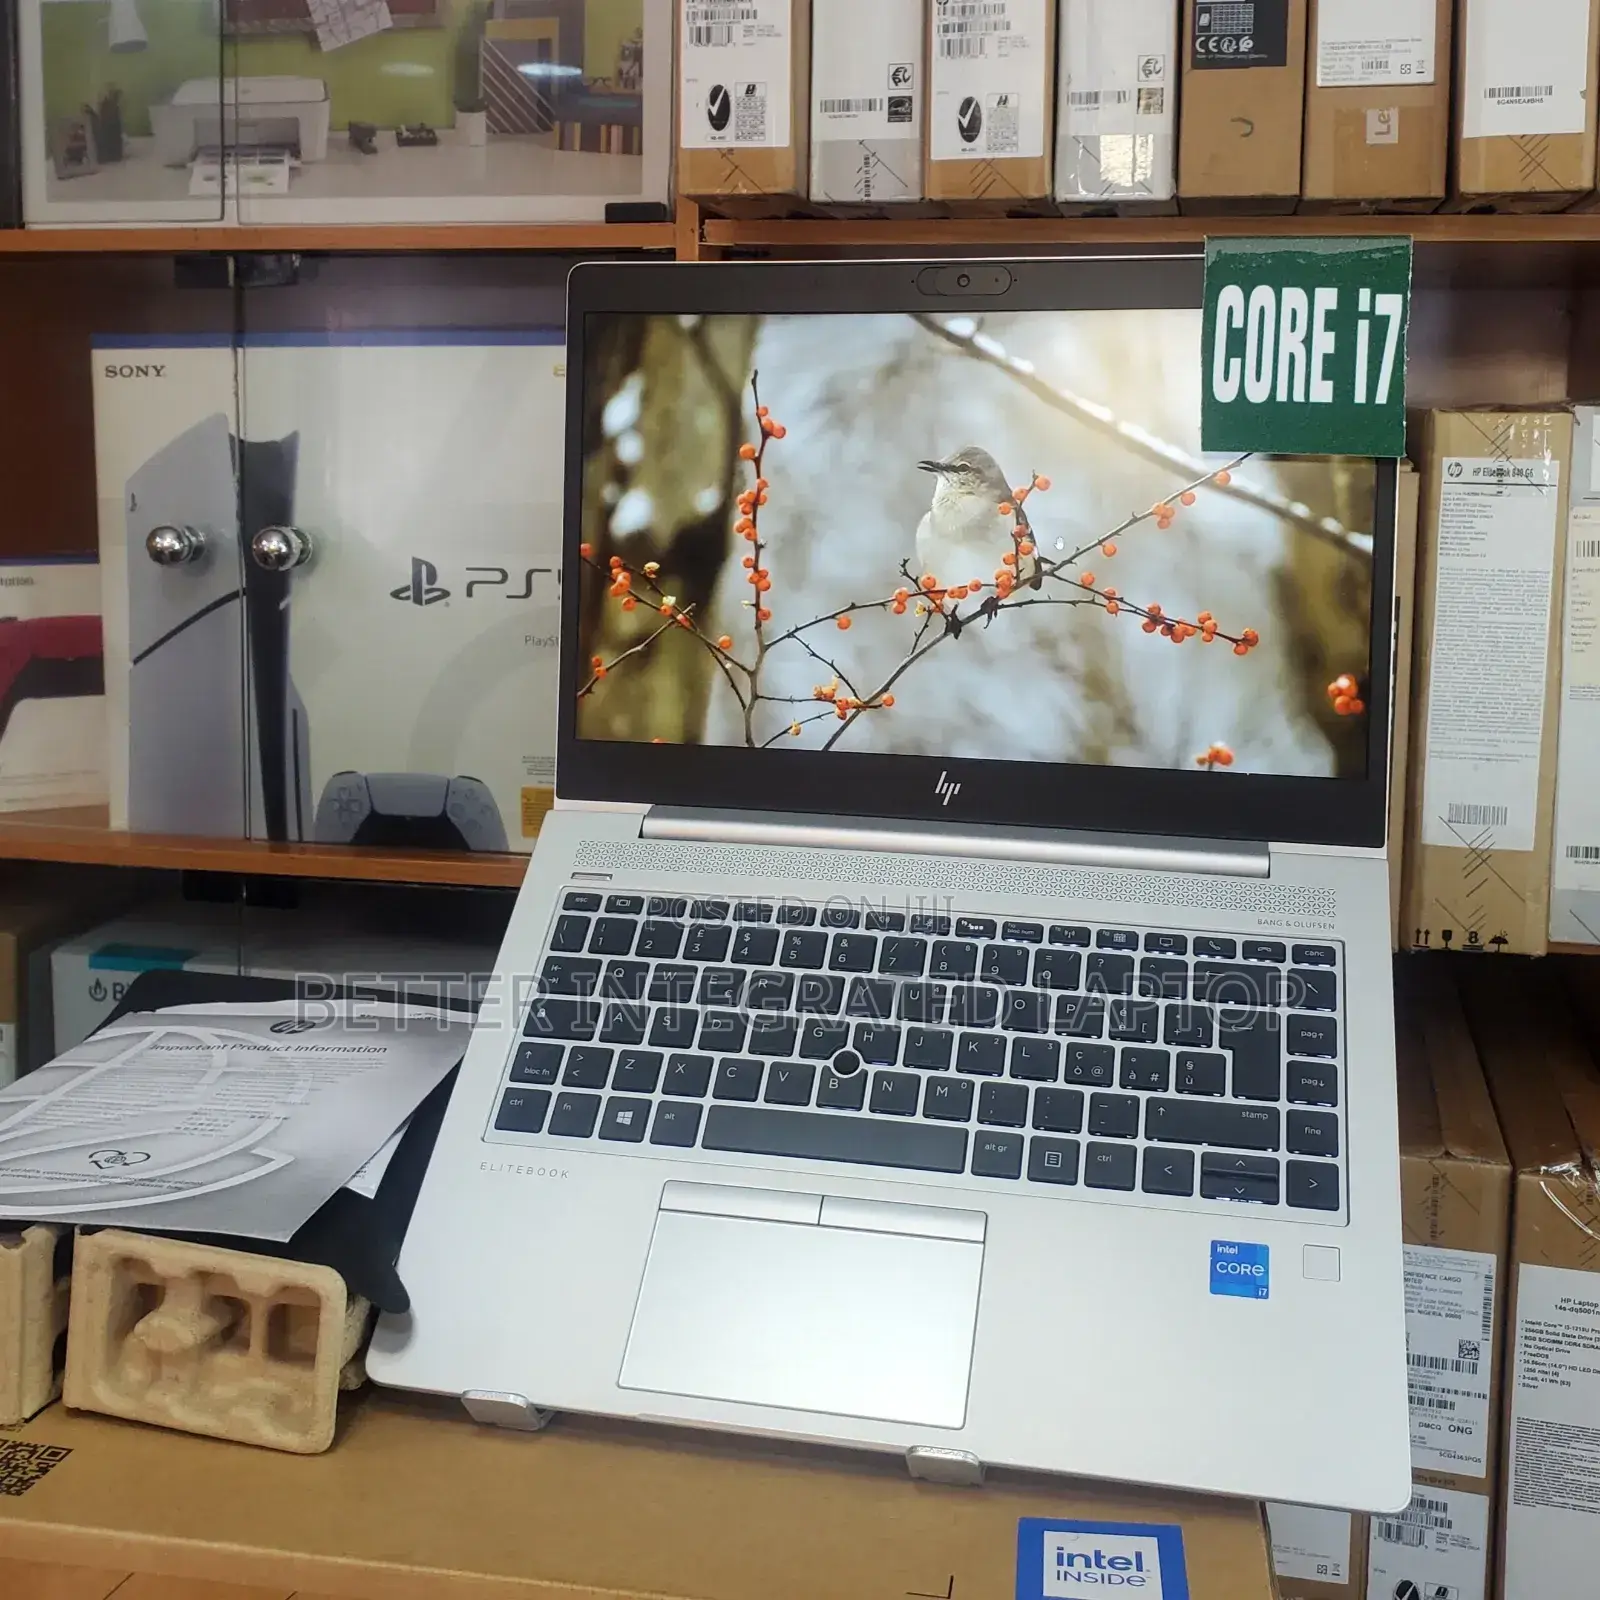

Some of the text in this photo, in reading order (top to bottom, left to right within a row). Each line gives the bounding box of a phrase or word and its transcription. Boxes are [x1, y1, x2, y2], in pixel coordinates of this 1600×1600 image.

[1212, 285, 1403, 405] CORE i7
[105, 364, 166, 378] SONY
[935, 771, 961, 805] hp
[1257, 918, 1283, 928] BANG
[1293, 920, 1335, 930] OLUFSEN
[644, 940, 653, 949] 2
[692, 943, 700, 952] 3
[740, 947, 749, 956] 4
[788, 951, 797, 960] 5
[1304, 949, 1325, 958] canc
[838, 954, 846, 963] 6
[889, 958, 897, 966] 7
[939, 961, 948, 971] 8
[991, 966, 999, 976] 9
[614, 968, 625, 978] Q
[663, 971, 677, 982] W
[759, 979, 768, 989] R
[910, 990, 920, 1000] U
[1067, 1004, 1076, 1014] P
[613, 1012, 624, 1023] A
[662, 1016, 671, 1026] S
[813, 1027, 823, 1037] G
[863, 1032, 873, 1042] H
[1301, 1031, 1318, 1041] pag
[915, 1037, 924, 1047] J
[968, 1041, 979, 1052] K
[150, 1043, 388, 1054] Important Product Information
[1022, 1047, 1030, 1058] L
[625, 1059, 636, 1070] Z
[675, 1063, 686, 1074] X
[524, 1067, 540, 1076] bloc
[726, 1067, 737, 1078] C
[778, 1071, 789, 1082] V
[829, 1078, 839, 1089] B
[882, 1081, 893, 1092] N
[1301, 1078, 1318, 1088] pag
[935, 1086, 948, 1097] M
[509, 1098, 523, 1106] ctrl
[562, 1103, 571, 1111] fn
[664, 1112, 675, 1120] alt
[1242, 1110, 1269, 1120] stamp
[1304, 1126, 1321, 1136] fine
[984, 1143, 996, 1151] alt
[1097, 1154, 1112, 1163] ctrl
[480, 1161, 569, 1179] ELITEBOOK
[1217, 1244, 1238, 1255] intel
[1258, 1288, 1267, 1296] i7
[1560, 1297, 1599, 1308] HP Laptop
[1448, 1424, 1473, 1435] ONG
[1056, 1546, 1144, 1573] intel
